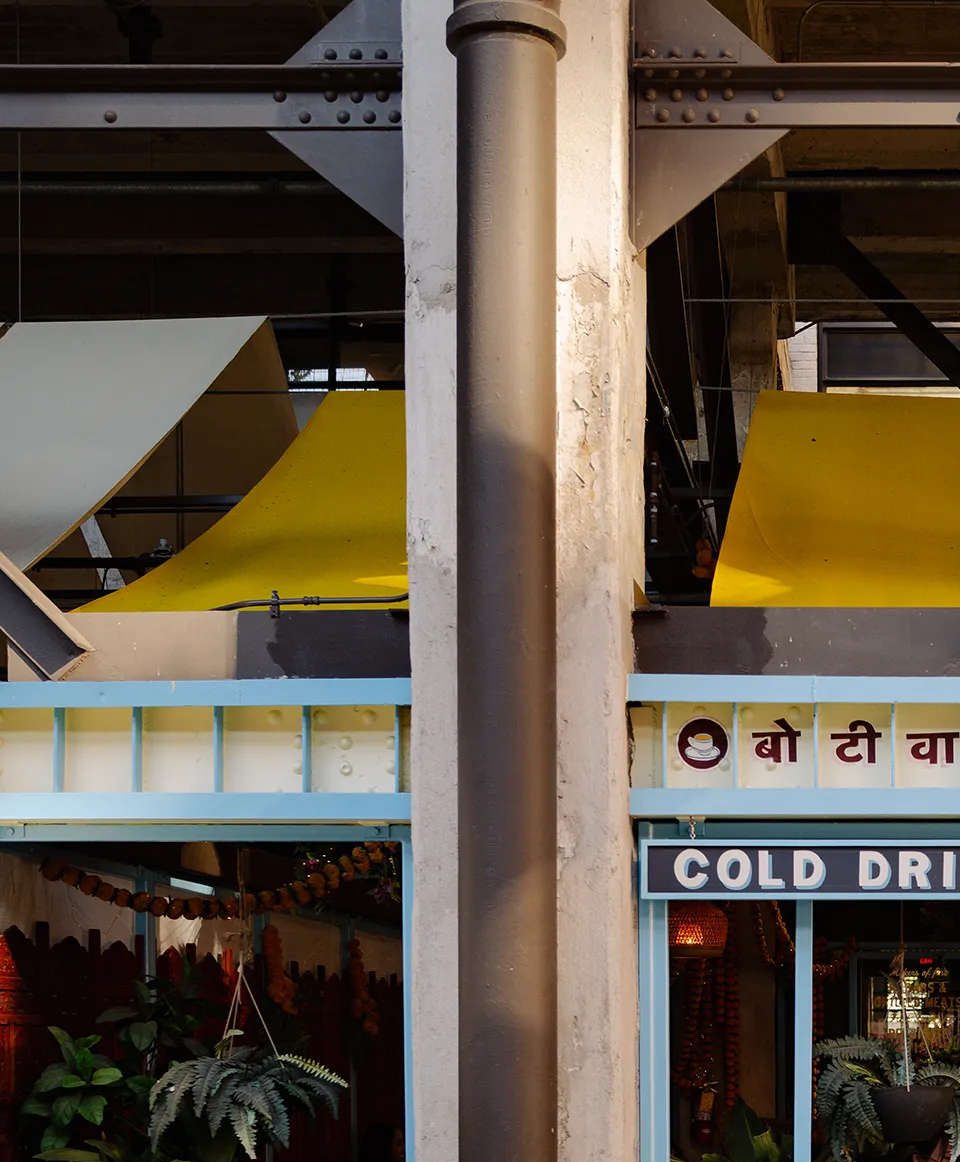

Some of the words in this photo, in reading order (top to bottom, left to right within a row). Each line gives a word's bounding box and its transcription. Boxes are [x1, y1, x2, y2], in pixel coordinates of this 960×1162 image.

[752, 718, 802, 764] बो
[830, 719, 882, 766] टी
[906, 731, 960, 765] वा
[673, 849, 826, 891] COLD
